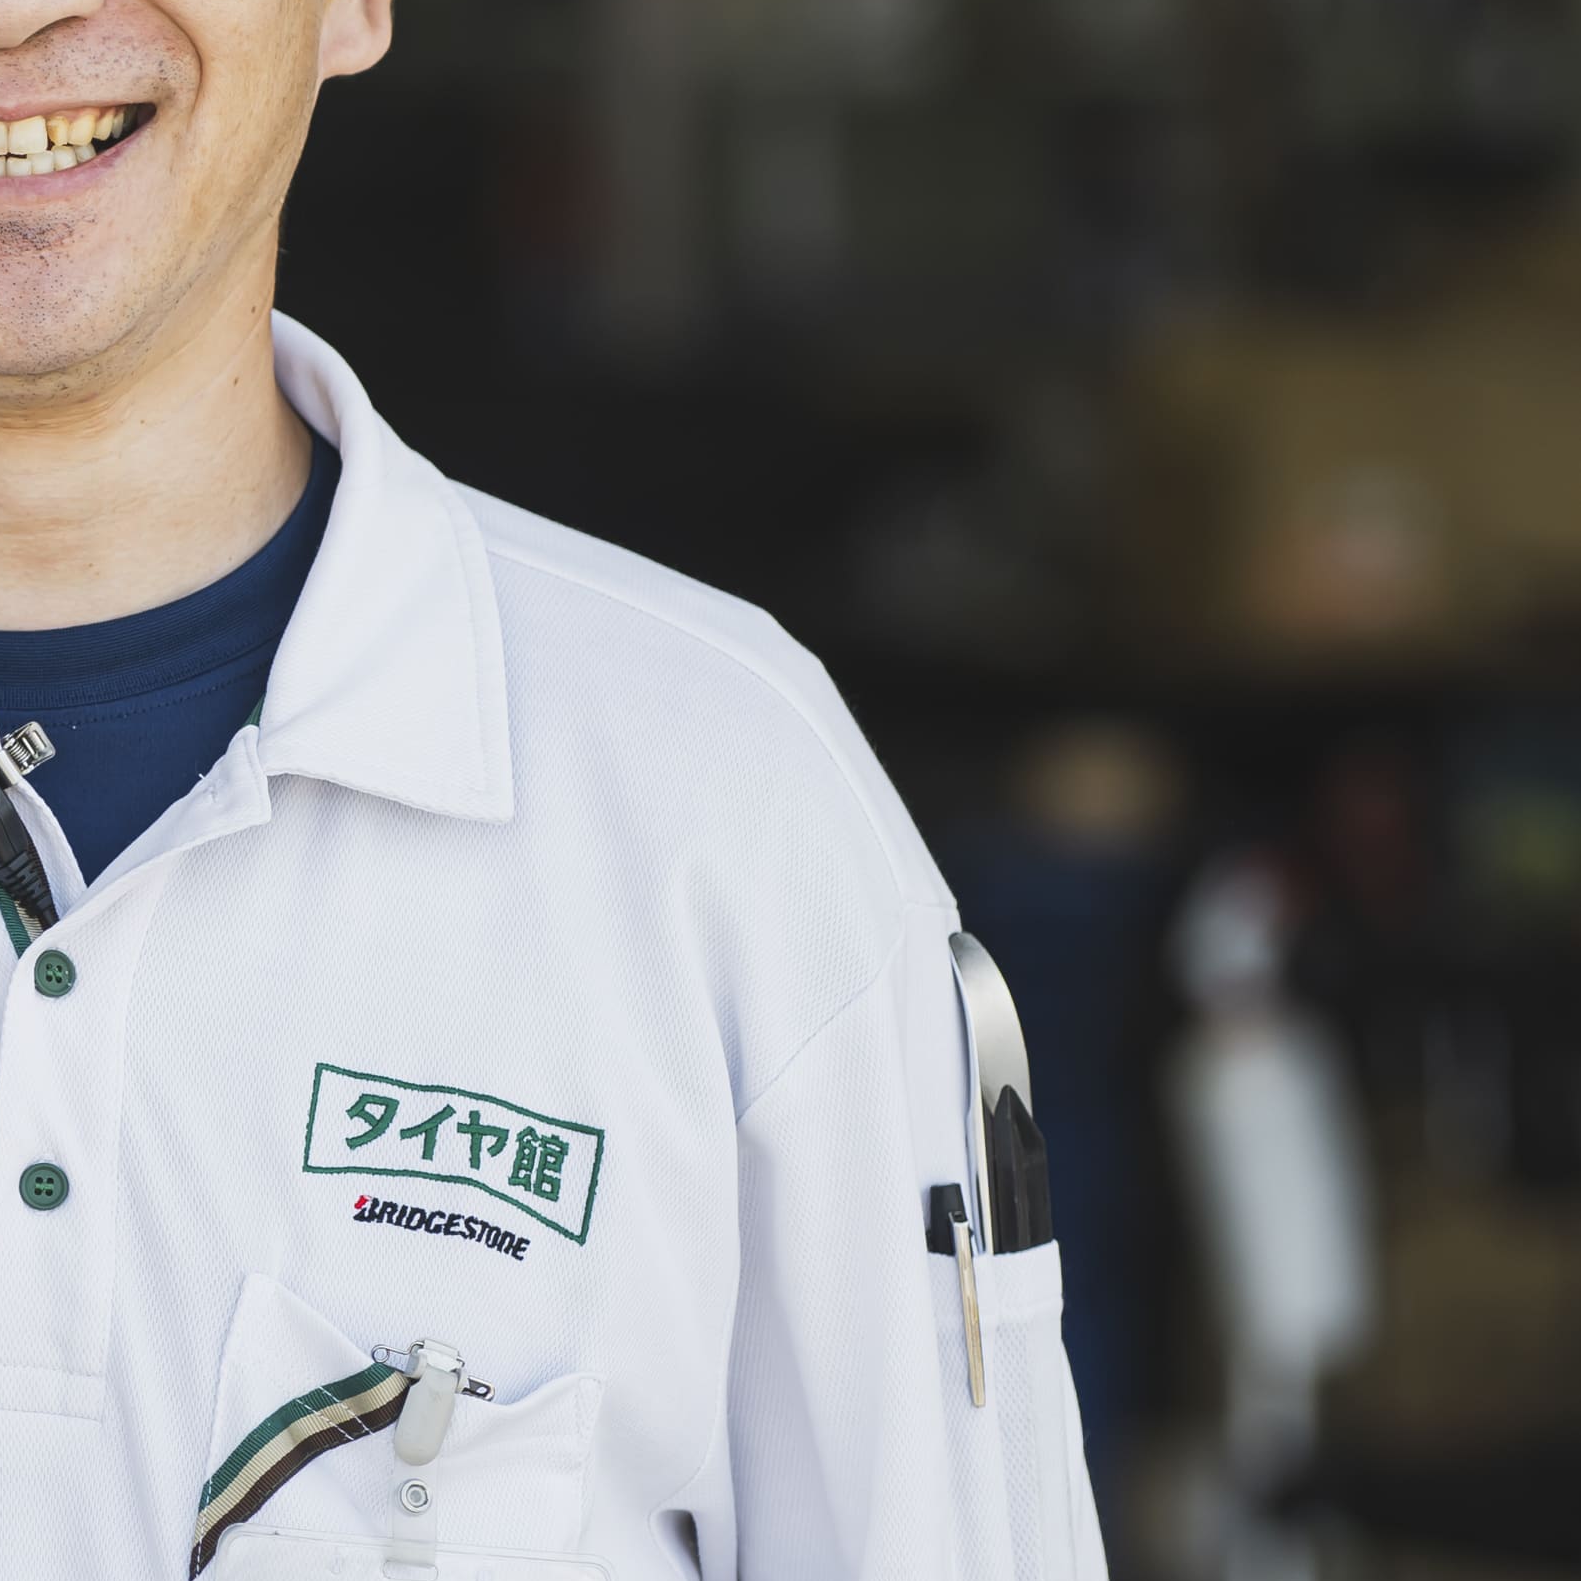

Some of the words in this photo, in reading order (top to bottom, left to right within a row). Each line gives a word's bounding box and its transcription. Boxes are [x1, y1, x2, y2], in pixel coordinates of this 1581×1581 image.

[345, 1093, 569, 1202] タイヤ館
[353, 1194, 531, 1261] BRIDGESTONE
